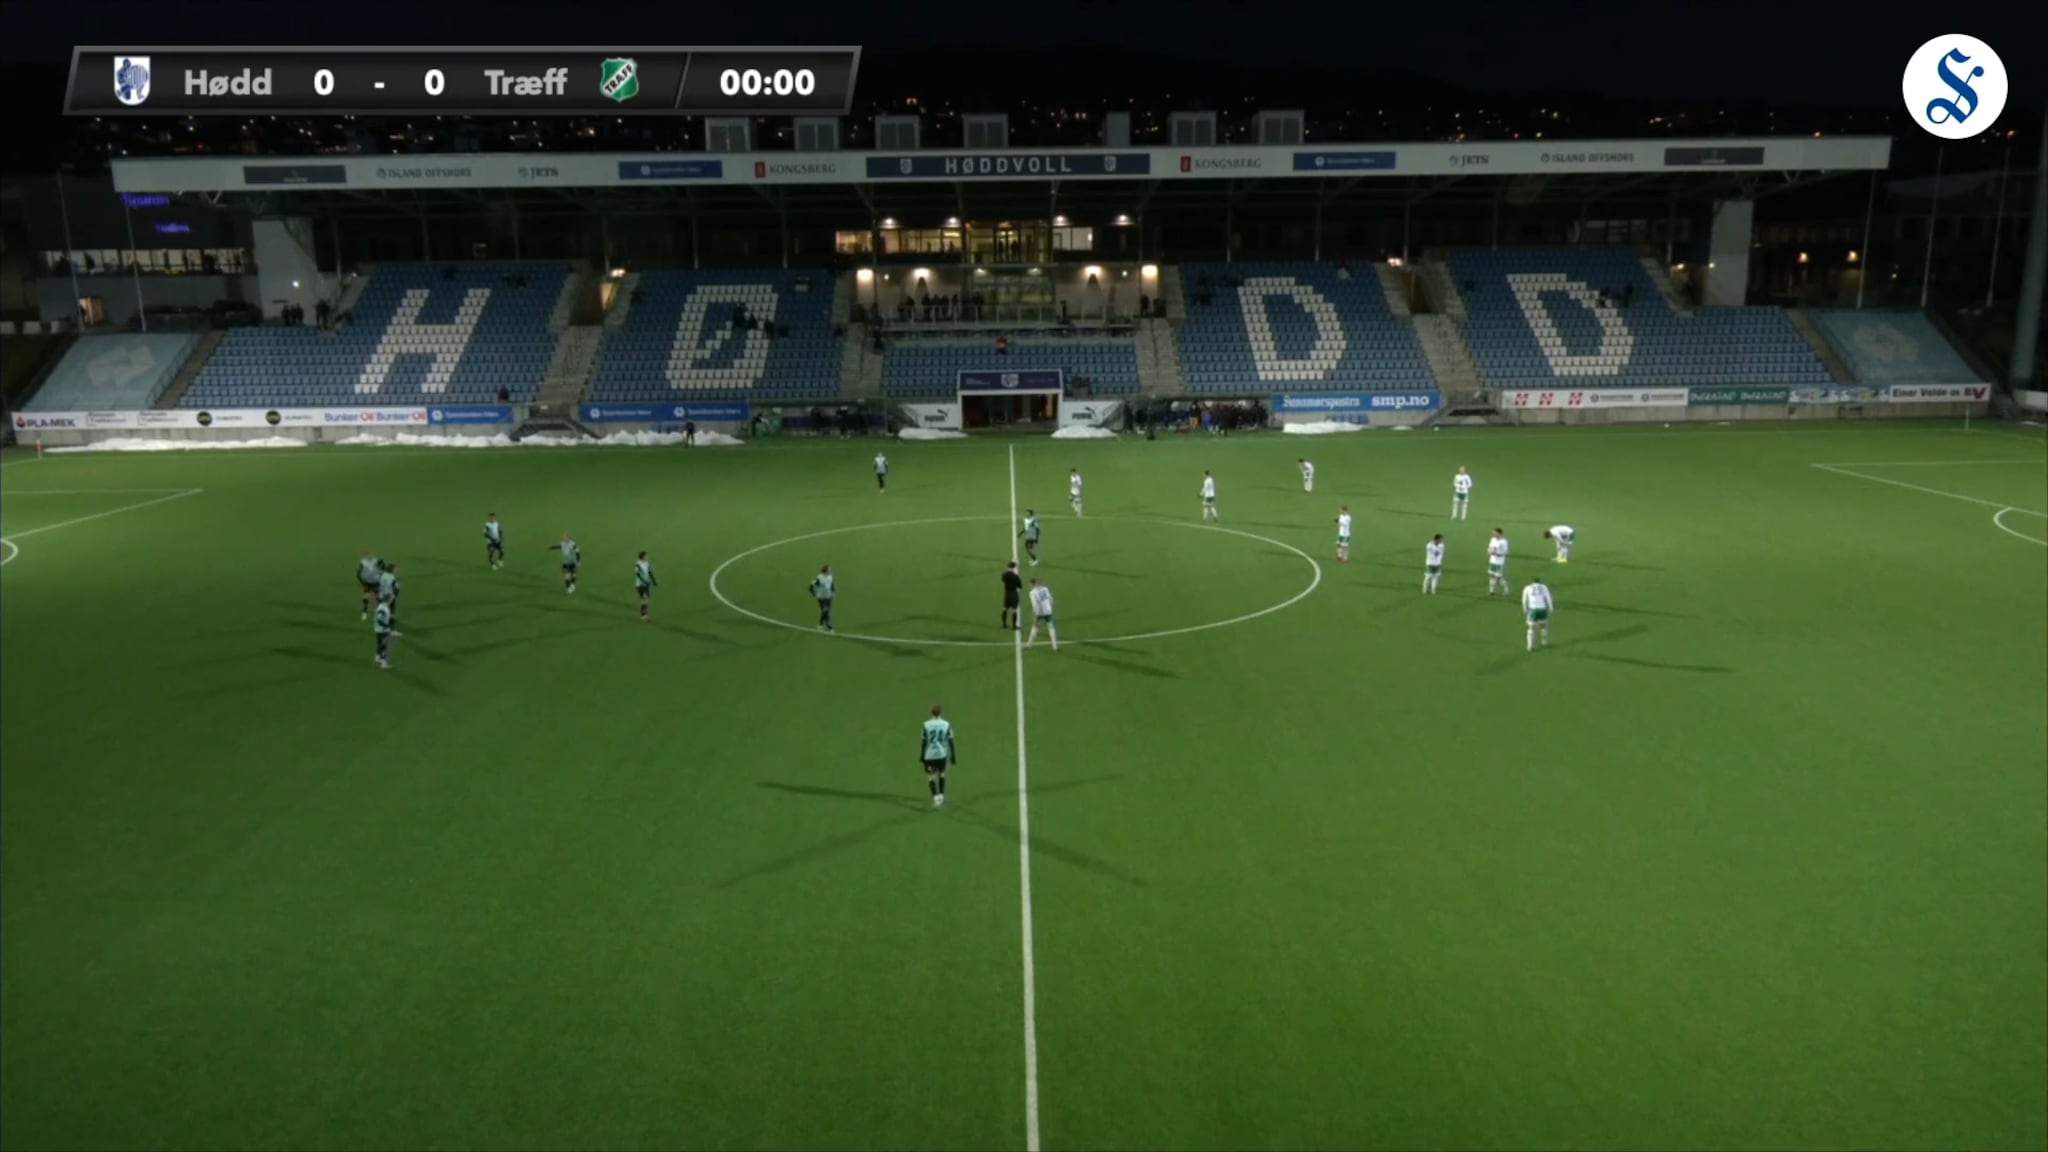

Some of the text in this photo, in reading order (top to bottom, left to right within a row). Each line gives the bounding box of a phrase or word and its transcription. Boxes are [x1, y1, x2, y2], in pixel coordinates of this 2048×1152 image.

[1194, 157, 1262, 170] KONGSBERG
[1461, 154, 1490, 167] JETS
[1551, 153, 1586, 163] ISLAND
[769, 162, 837, 175] KONGSBERG
[945, 156, 1073, 174] HØDDVOLL
[354, 288, 491, 393] H
[1237, 276, 1347, 380] D
[1506, 273, 1634, 376] D
[1371, 393, 1431, 409] smp.no
[324, 412, 358, 422] Bunker
[359, 411, 375, 422] Oil
[376, 410, 427, 422] Bunker Oil
